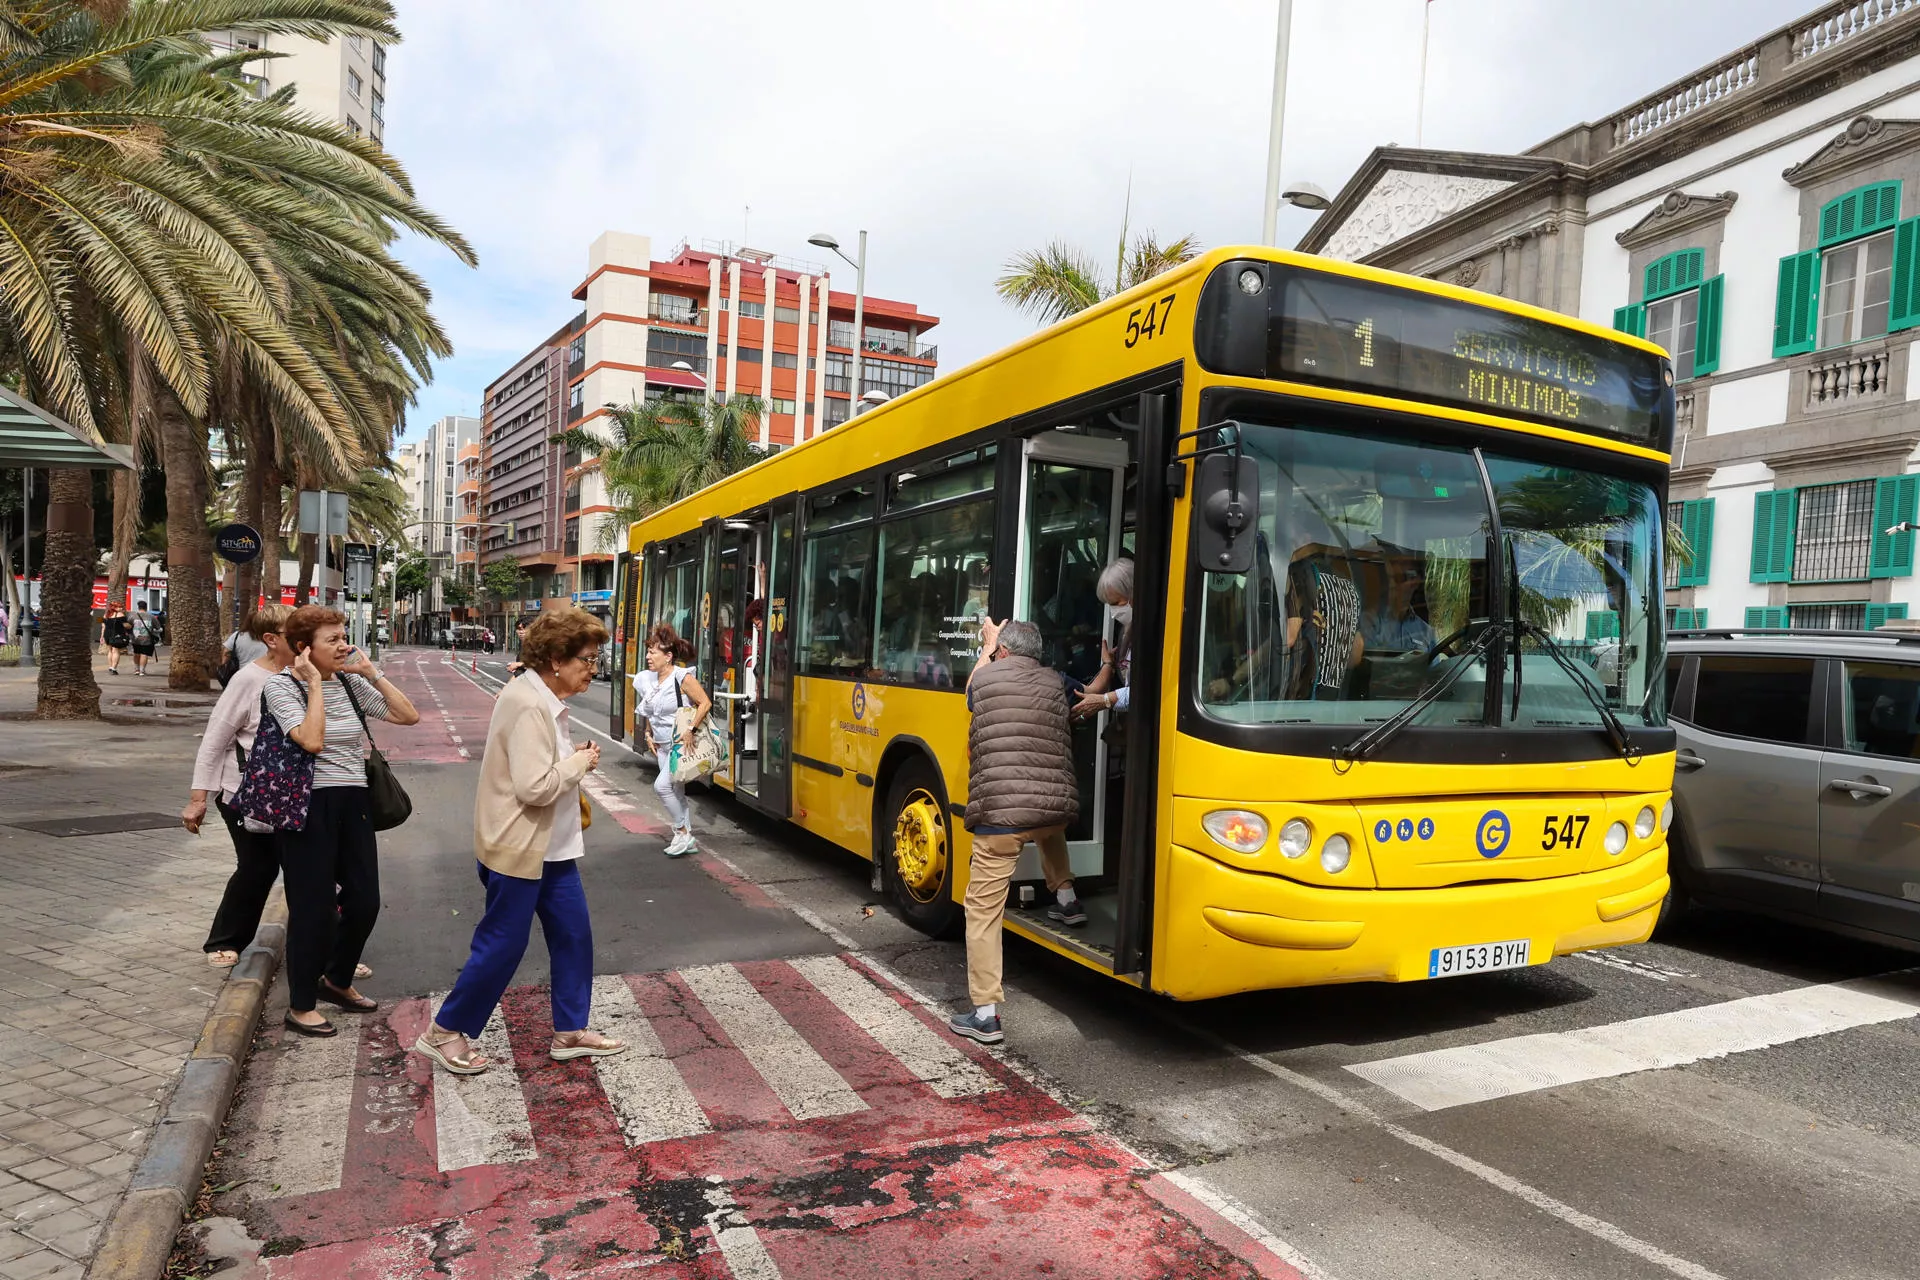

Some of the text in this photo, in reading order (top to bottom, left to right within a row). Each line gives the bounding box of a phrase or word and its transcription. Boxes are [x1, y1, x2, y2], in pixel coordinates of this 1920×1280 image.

[1124, 293, 1176, 348] 547
[1354, 318, 1374, 367] 1
[1453, 329, 1597, 386] SERVICIOS
[1467, 369, 1580, 419] MINIMOS
[681, 748, 716, 763] RITUALS
[1541, 815, 1590, 851] 547
[1442, 943, 1526, 972] 9153 BYH
